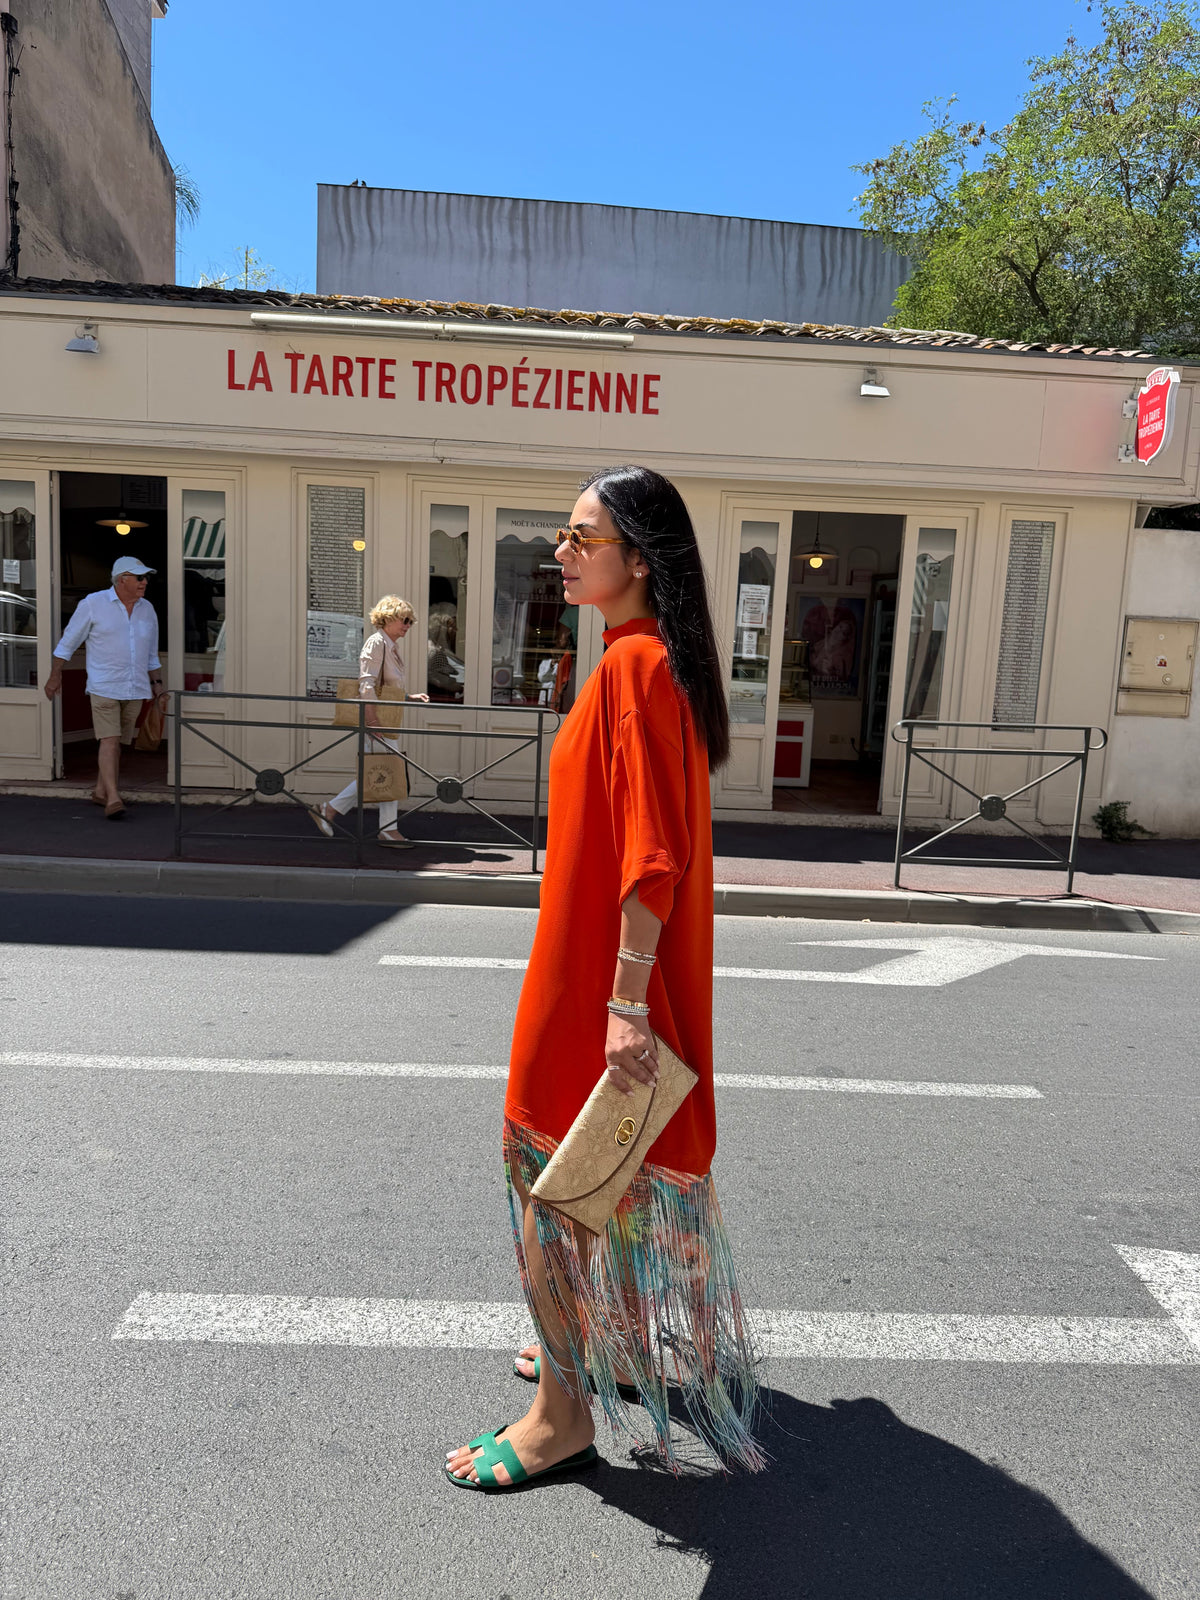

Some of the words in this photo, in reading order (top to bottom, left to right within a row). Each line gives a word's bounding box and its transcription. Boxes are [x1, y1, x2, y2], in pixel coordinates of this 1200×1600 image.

[227, 349, 273, 392] LA
[284, 352, 396, 399] TARTE
[412, 356, 661, 415] TROPÉZIENNE
